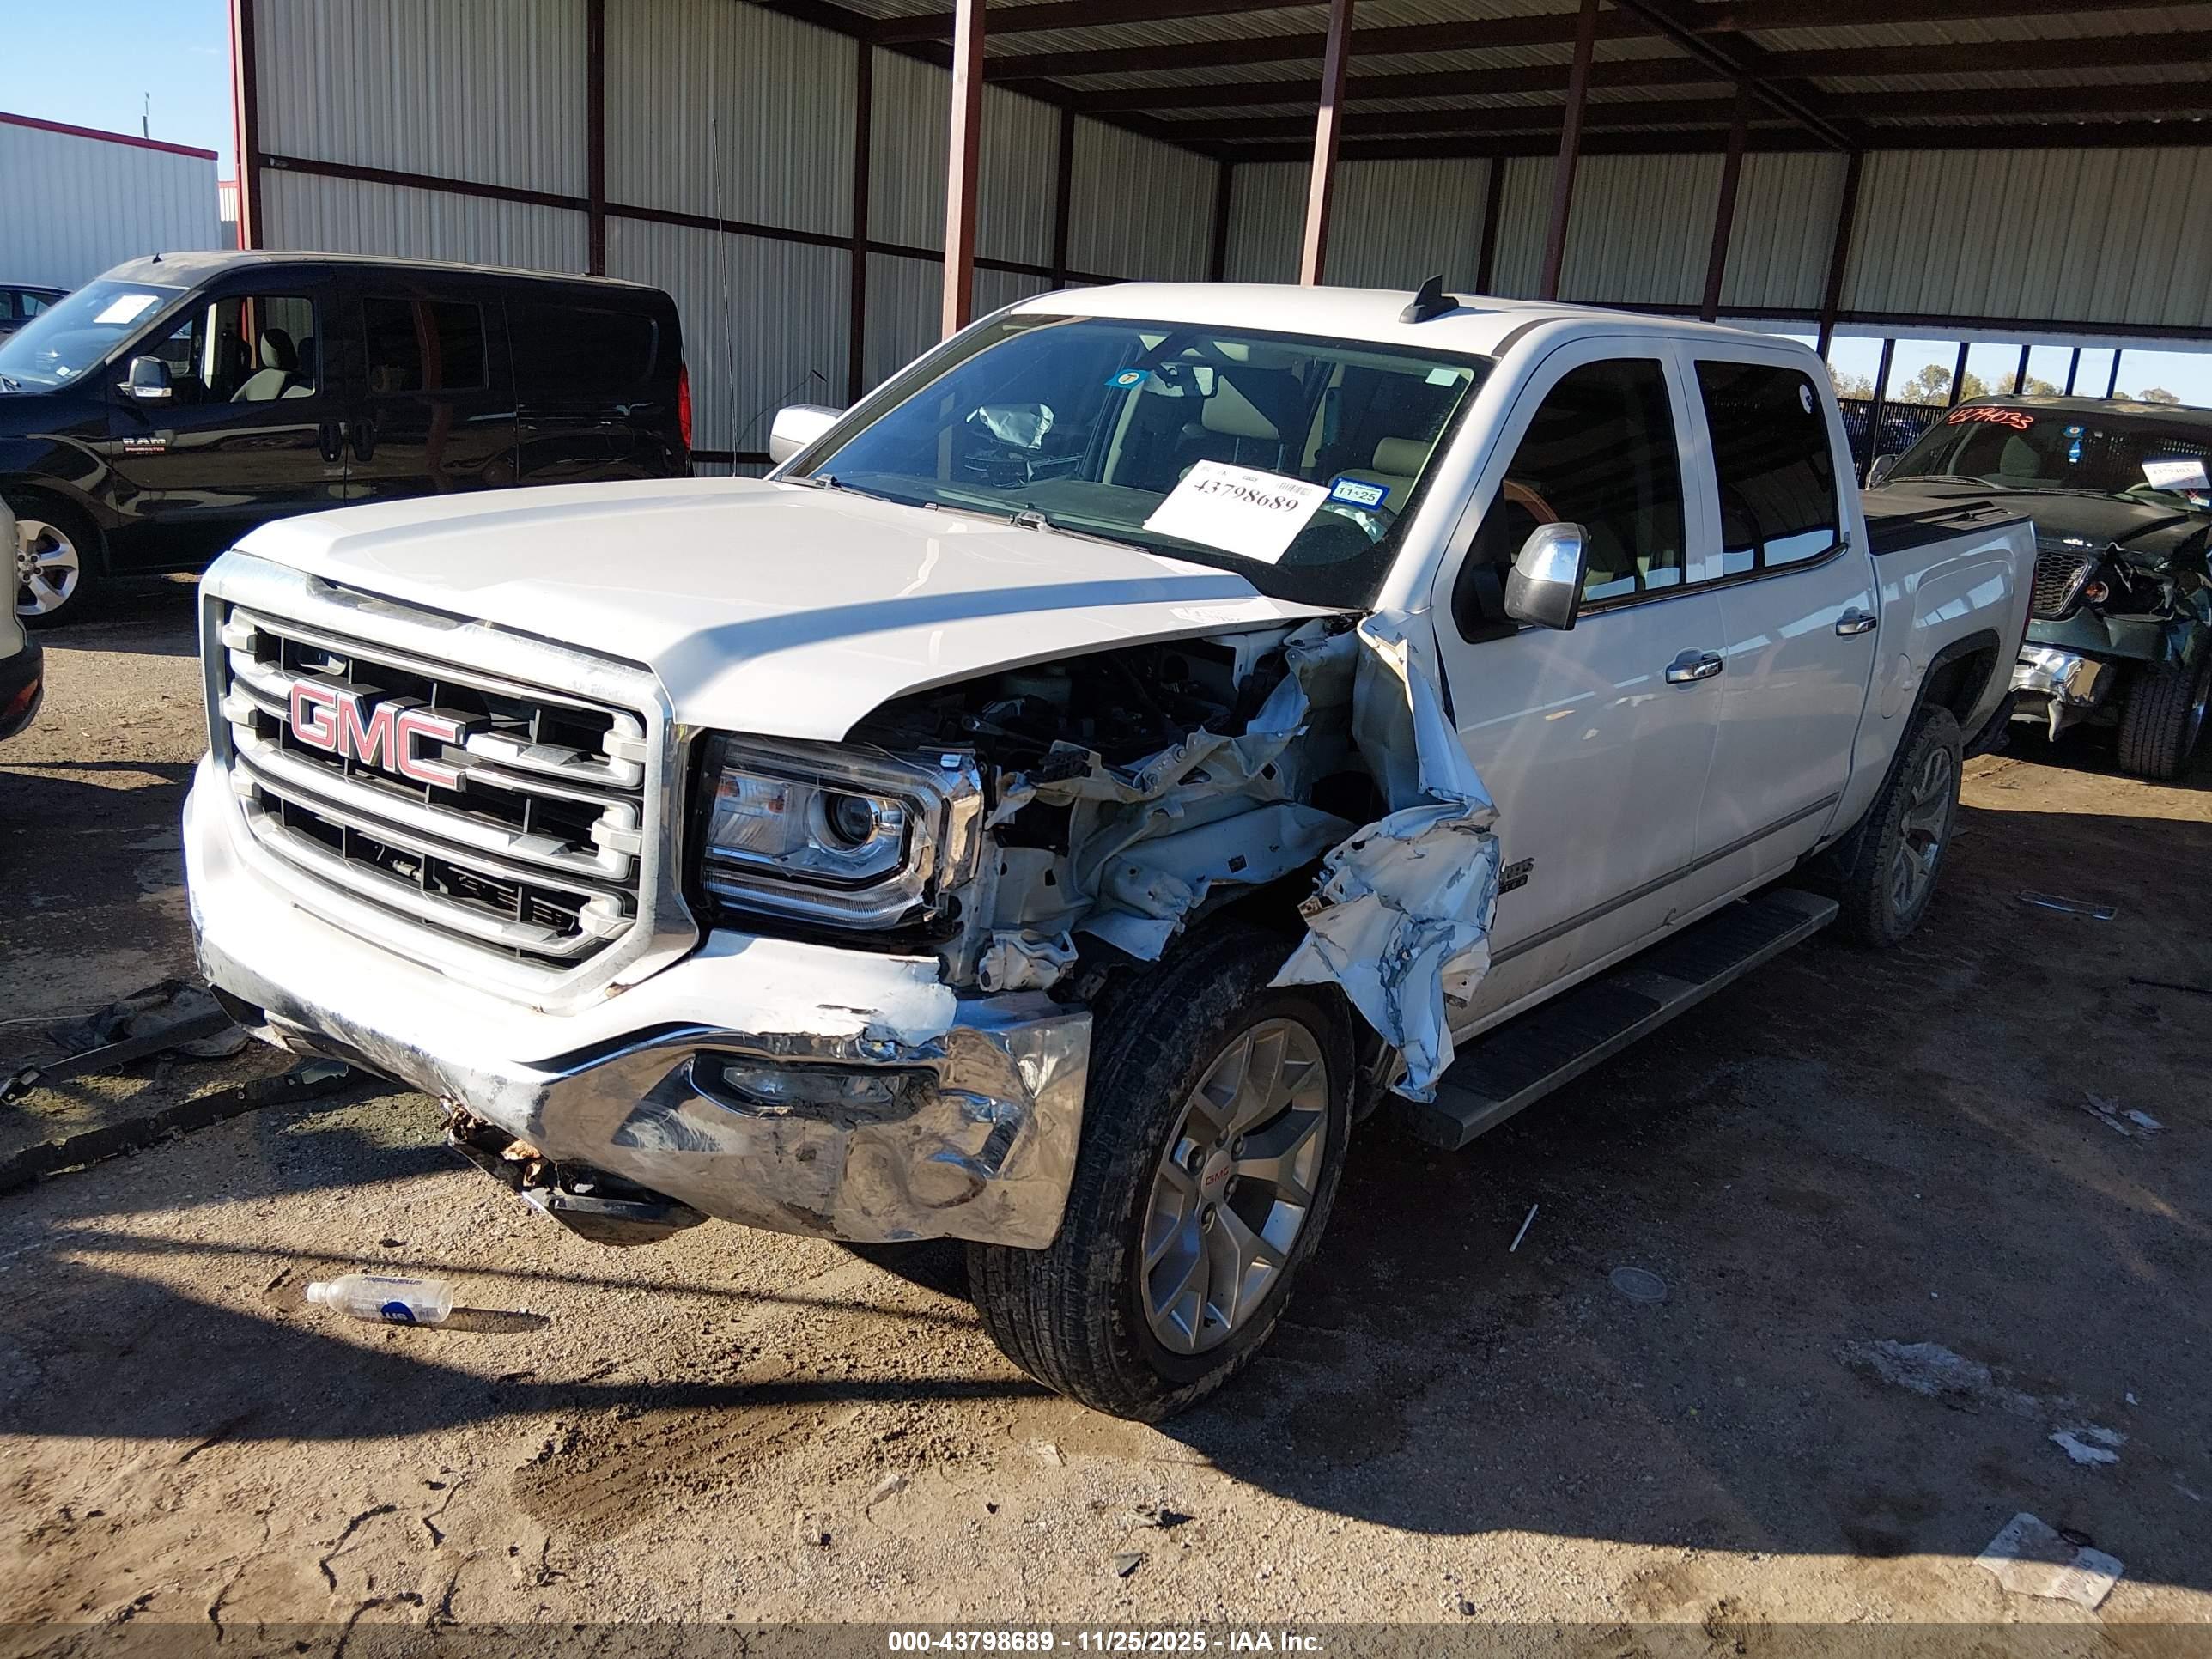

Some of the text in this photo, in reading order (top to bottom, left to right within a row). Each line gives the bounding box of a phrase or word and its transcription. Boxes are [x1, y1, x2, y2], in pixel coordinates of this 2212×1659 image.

[1194, 479, 1299, 512] 43798689
[291, 678, 465, 792] GMC
[1205, 1166, 1230, 1186] GMC
